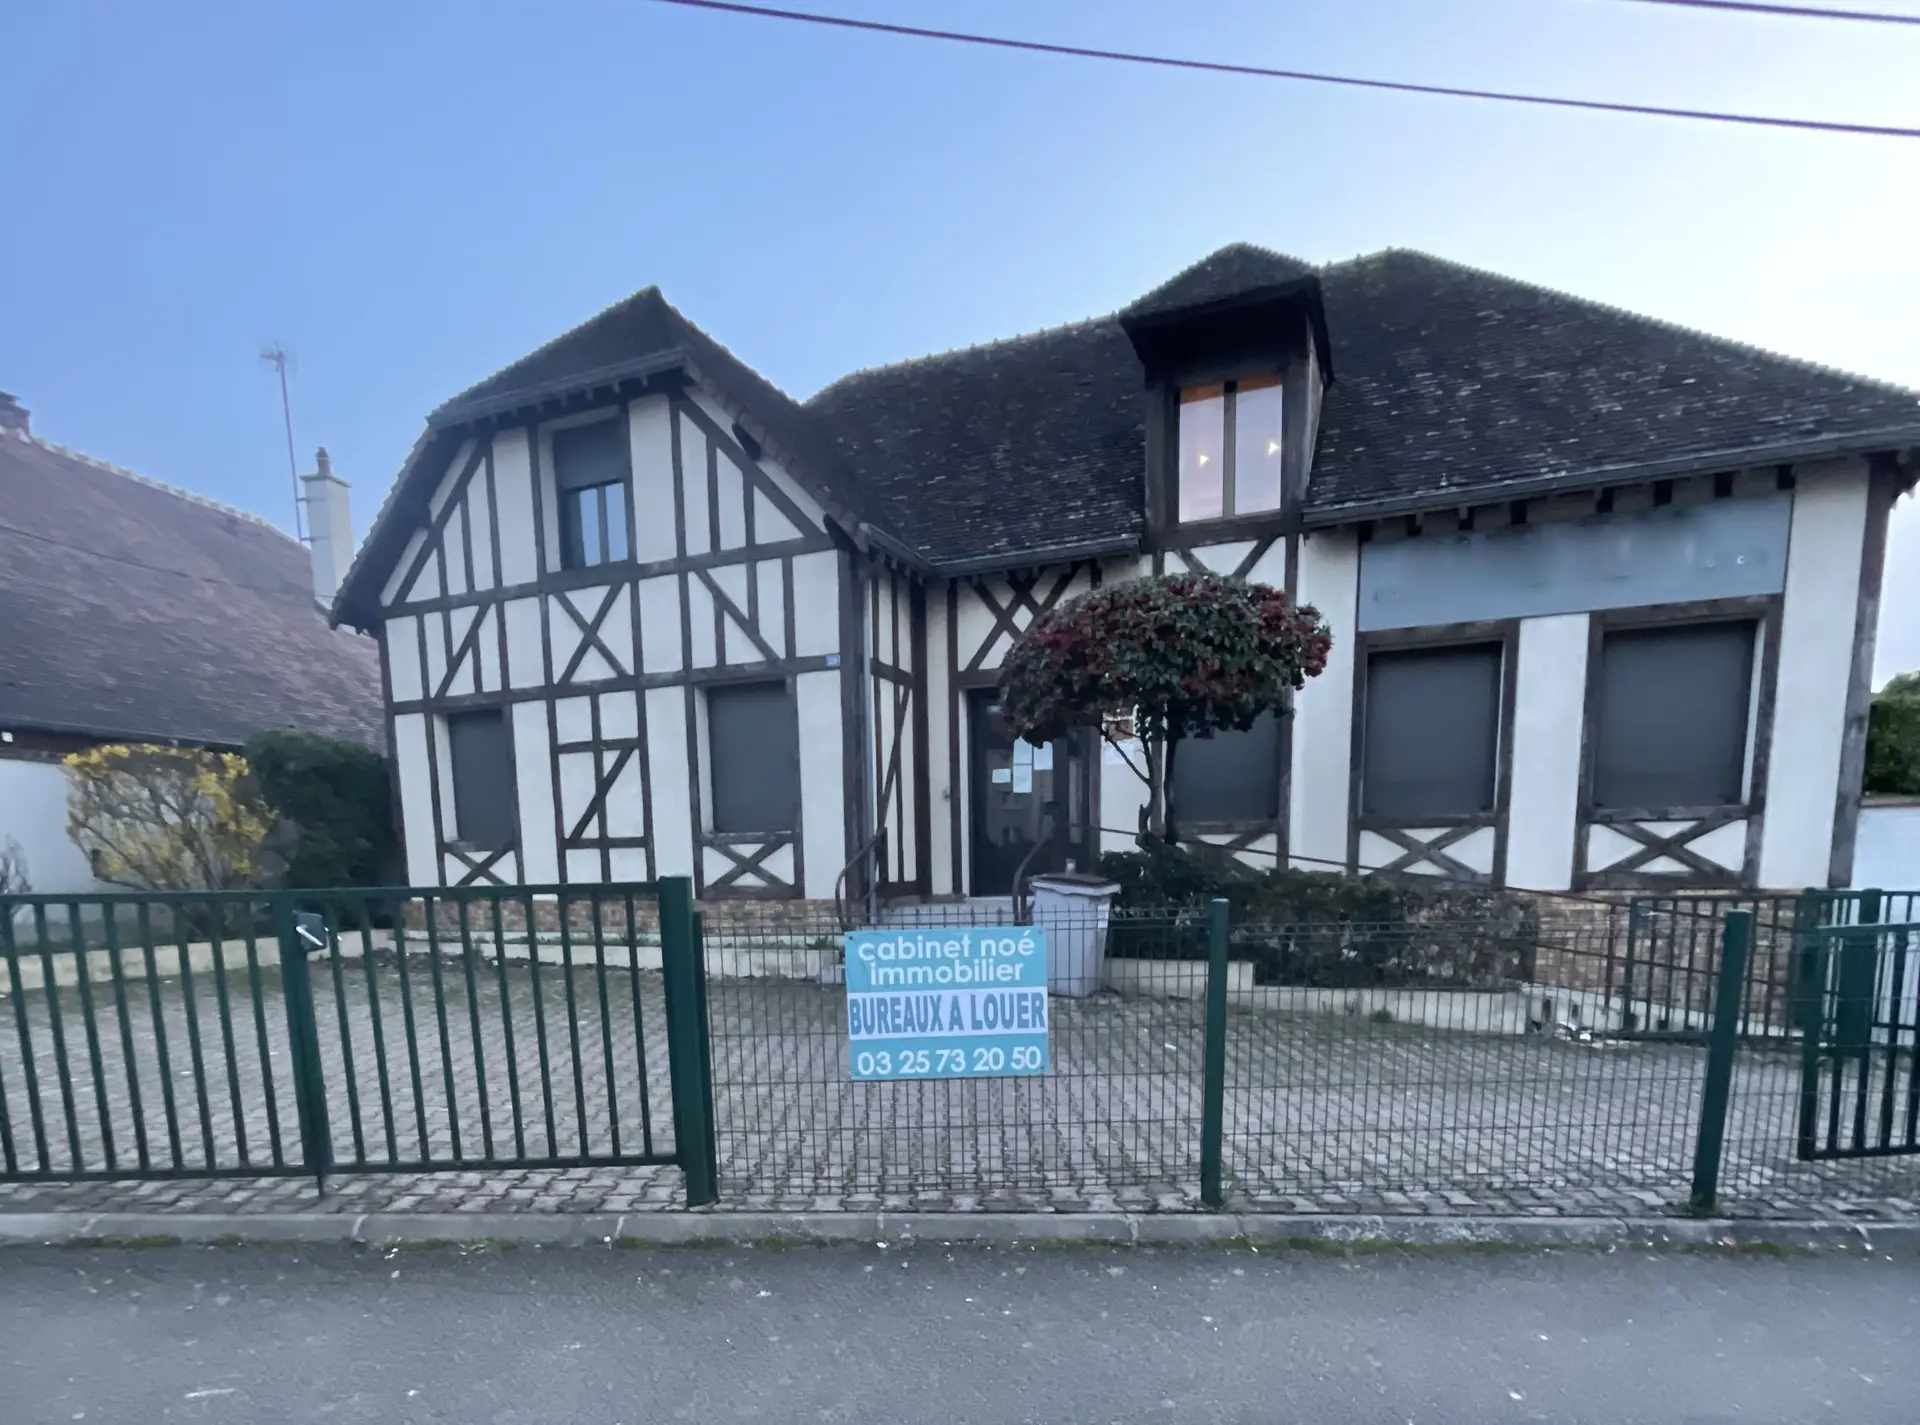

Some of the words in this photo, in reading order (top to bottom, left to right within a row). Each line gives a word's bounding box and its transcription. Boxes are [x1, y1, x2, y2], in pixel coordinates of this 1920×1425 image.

[858, 935, 971, 961] cabinet
[980, 929, 1035, 958] noé
[870, 958, 1024, 986] immobilier
[850, 995, 944, 1036] BUREAUX
[949, 995, 965, 1031] A
[971, 992, 1046, 1031] LOUER
[857, 1051, 892, 1076] 03
[899, 1050, 930, 1074] 25
[936, 1049, 966, 1073] 73
[972, 1047, 1005, 1072] 20
[1010, 1046, 1042, 1070] 50
